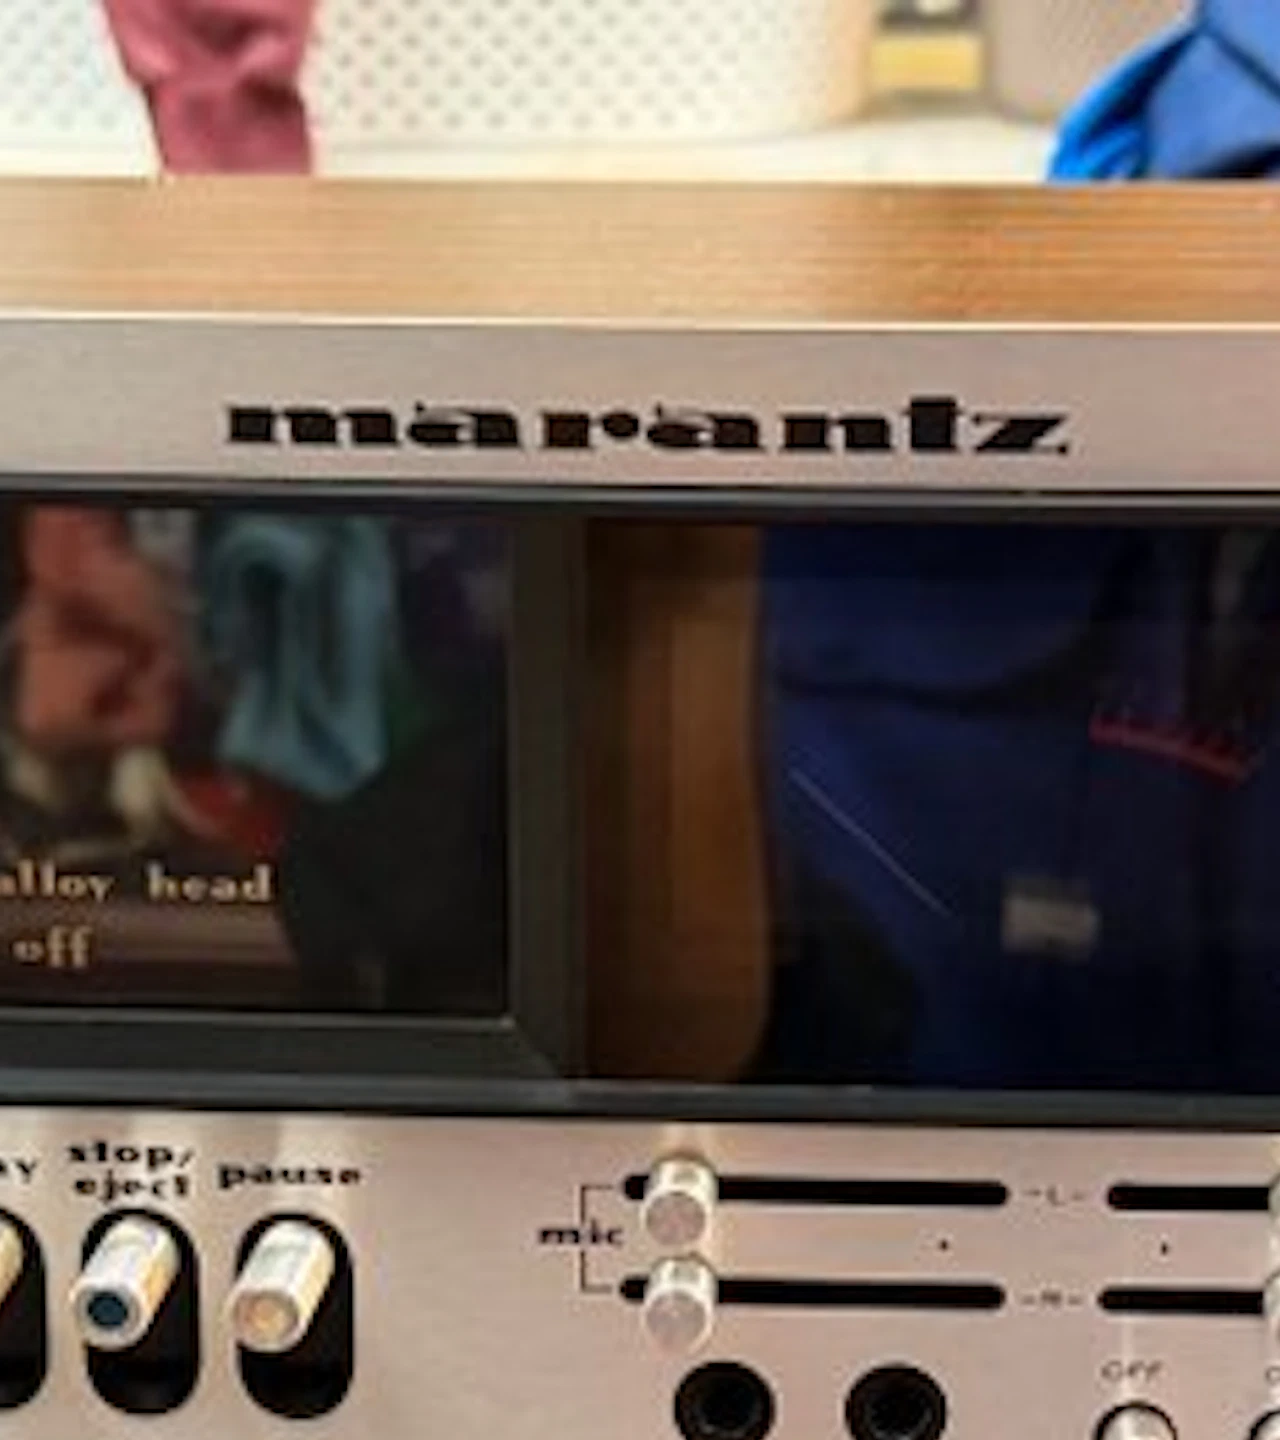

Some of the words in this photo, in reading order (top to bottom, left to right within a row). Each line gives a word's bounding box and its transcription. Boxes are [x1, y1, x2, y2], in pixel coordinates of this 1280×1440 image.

[226, 397, 1070, 455] marantz
[147, 863, 272, 903] head
[11, 926, 93, 968] off
[74, 1170, 192, 1203] eject
[218, 1161, 365, 1191] pause
[537, 1219, 624, 1248] mic
[1100, 1360, 1165, 1382] OFF
